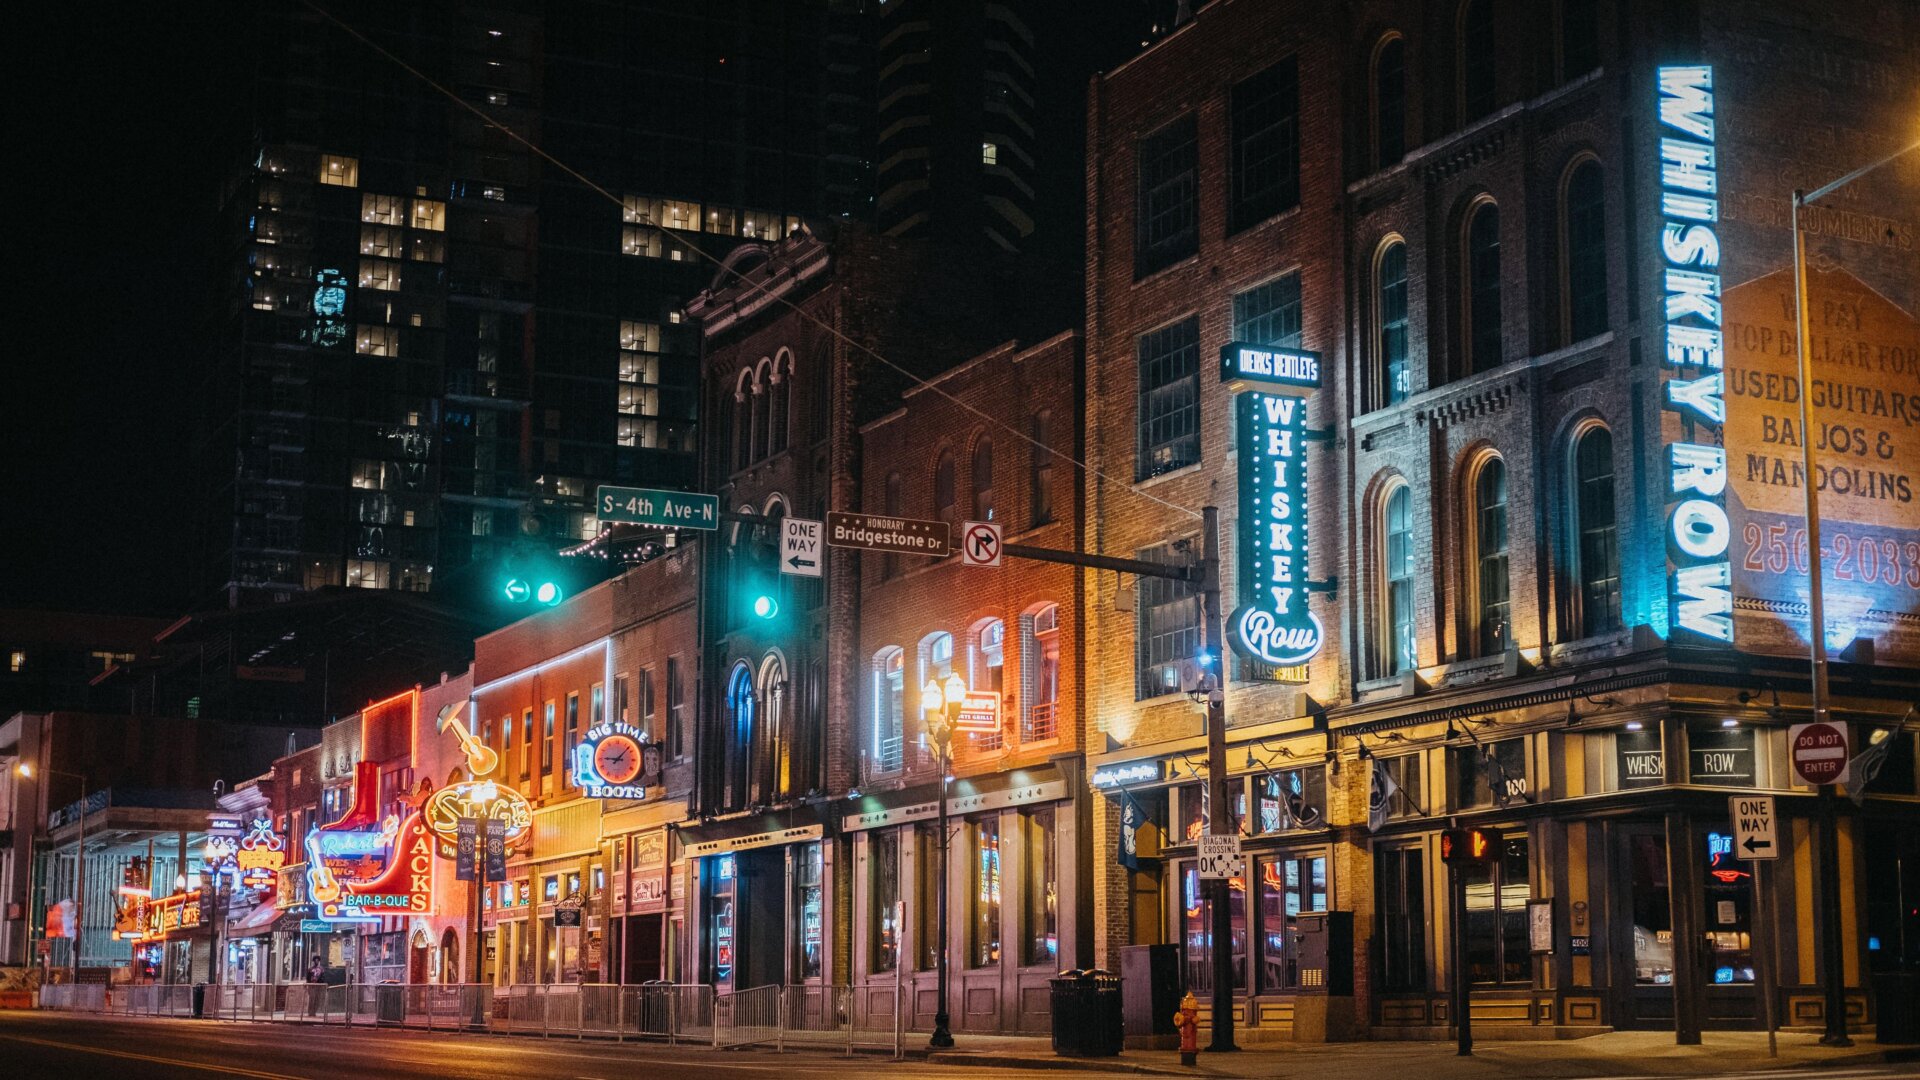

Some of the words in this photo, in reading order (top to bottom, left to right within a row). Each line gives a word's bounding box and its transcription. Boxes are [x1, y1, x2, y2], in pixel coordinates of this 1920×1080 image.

[1658, 65, 1725, 424] WHISKEY
[1824, 298, 1862, 332] PAY
[1728, 321, 1773, 355] TOP
[1779, 329, 1872, 373] DLLAR
[1879, 344, 1920, 384] FOR
[1729, 366, 1801, 405] USED
[1810, 378, 1920, 428] GUITARS
[1761, 414, 1868, 457] BAJOS
[1876, 431, 1895, 460] &
[1264, 397, 1296, 614] WHISKEY
[789, 522, 816, 538] ONE
[867, 517, 905, 531] HONORARY
[788, 537, 816, 553] WAY
[834, 525, 925, 547] Bridgestone
[928, 537, 942, 549] Dr
[1671, 442, 1734, 643] ROW
[1253, 659, 1310, 682] NASHVILLE
[587, 723, 612, 741] BIG
[614, 722, 649, 744] TIME
[1800, 736, 1814, 747] DO
[1819, 734, 1839, 745] NOT
[1703, 753, 1735, 773] ROW
[1804, 761, 1836, 773] ENTER
[591, 785, 644, 798] BOOTS
[433, 789, 531, 833] STGE
[1740, 801, 1768, 816] ONE
[1740, 818, 1770, 833] WAY
[1203, 837, 1236, 846] DIAGONAL
[1203, 845, 1236, 854] CROSSING
[442, 844, 455, 857] ON
[1200, 857, 1217, 873] OK
[347, 895, 409, 907] BAR-B-QUE
